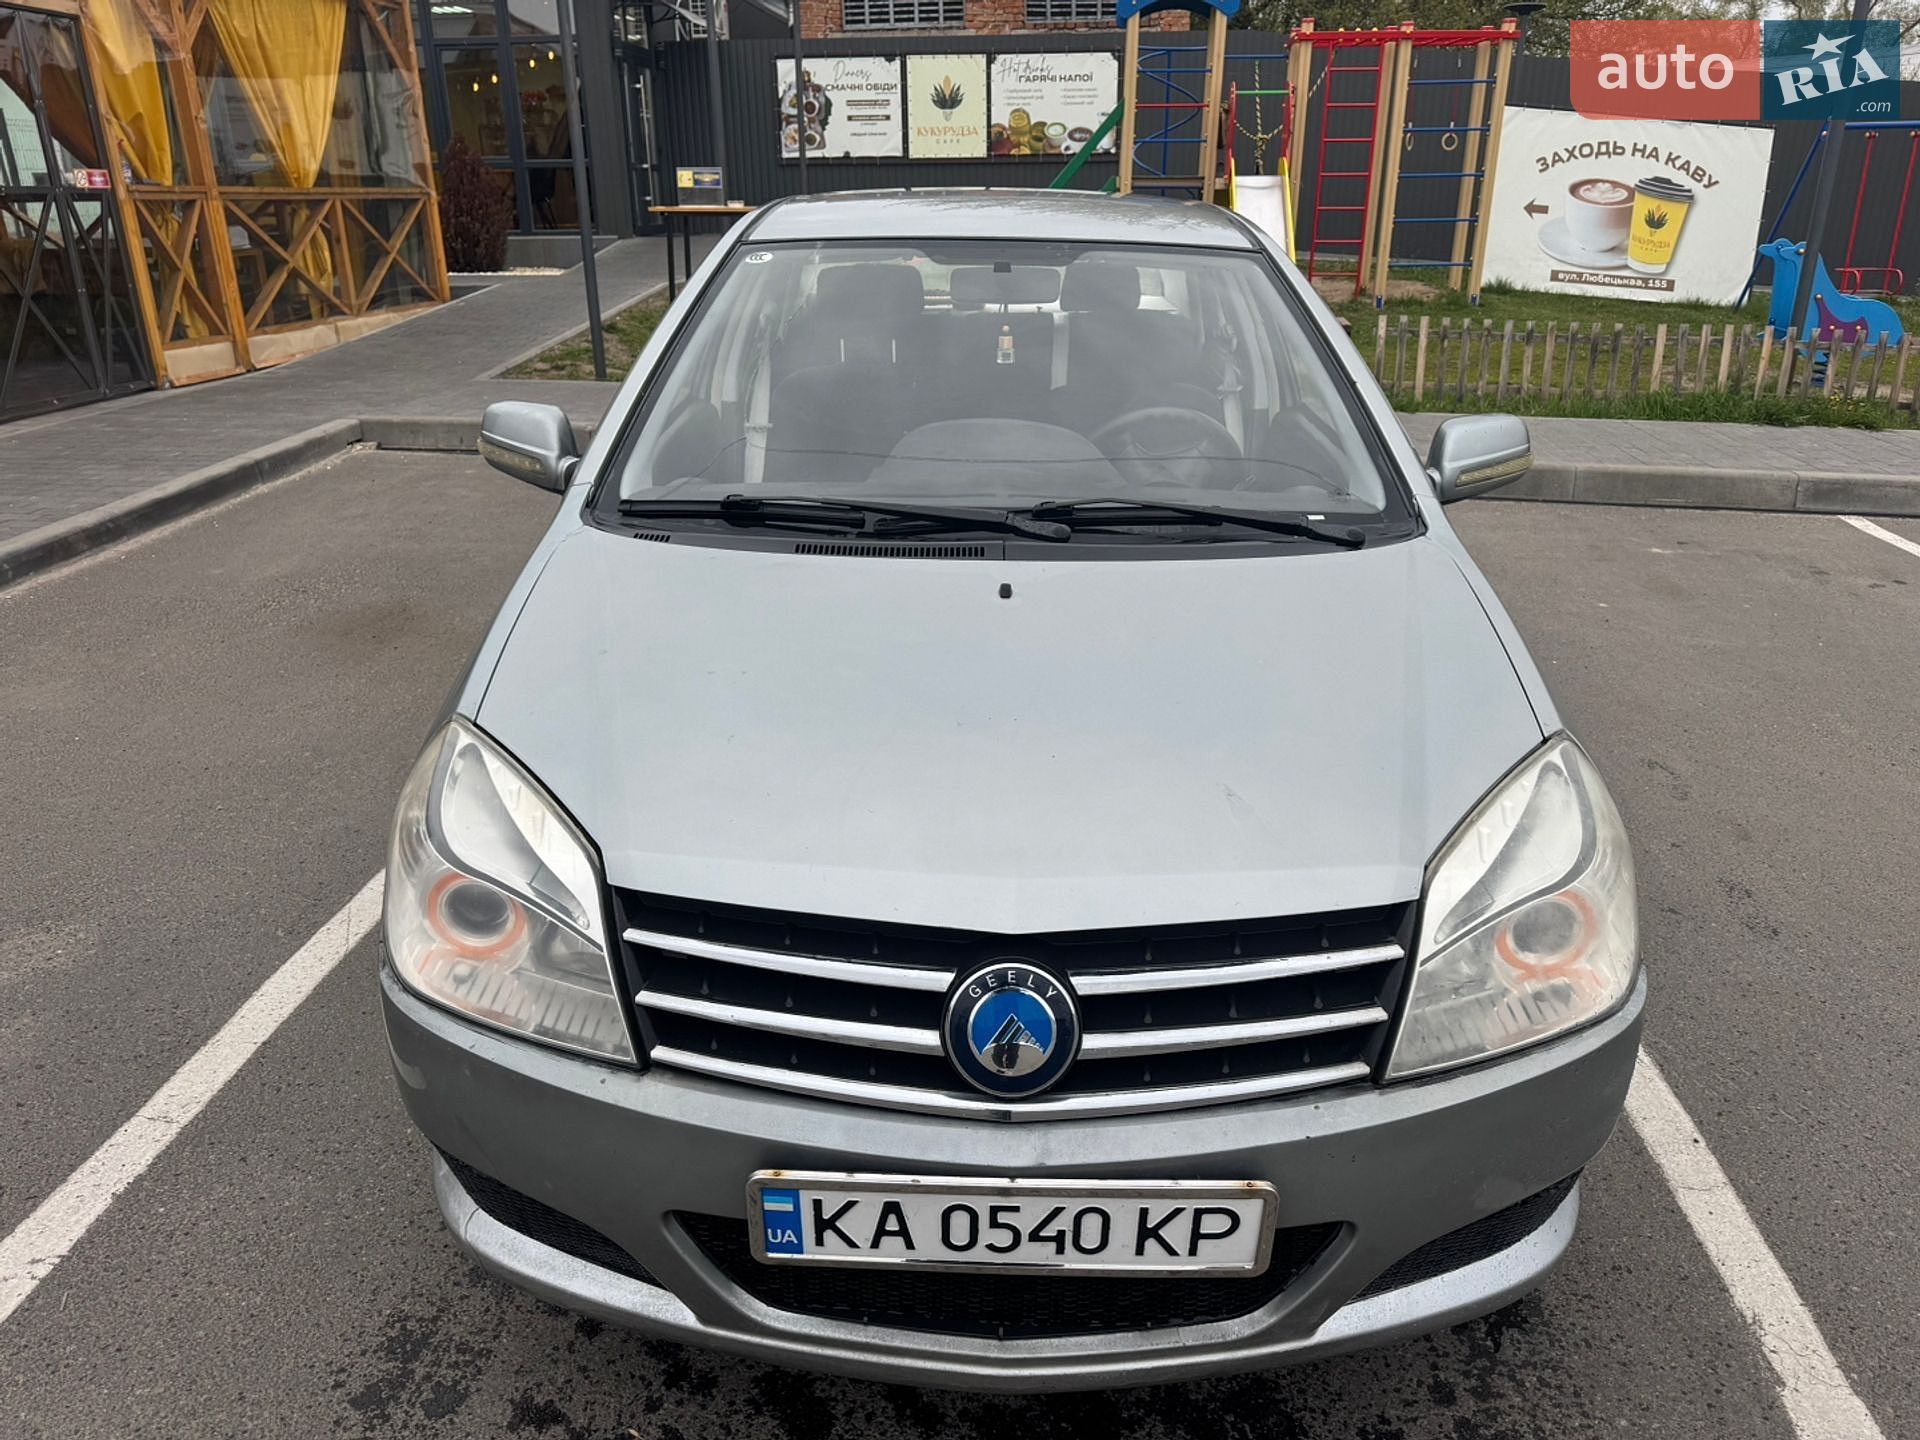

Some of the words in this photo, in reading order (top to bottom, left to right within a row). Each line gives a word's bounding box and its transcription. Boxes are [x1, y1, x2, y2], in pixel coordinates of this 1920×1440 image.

[1019, 74, 1057, 83] ГАРЯЧІ
[1059, 72, 1094, 83] НАПОЇ
[825, 83, 864, 92] СМАЧНІ
[865, 82, 898, 93] ОБІДИ
[916, 126, 979, 137] КУКУРУДЗА
[1536, 140, 1626, 173] ЗАХОДЬ
[1631, 142, 1660, 162] НА
[1664, 152, 1720, 189] КАВУ
[1647, 279, 1668, 289] 155
[969, 970, 1057, 999] GEELY
[812, 1198, 916, 1251] KA
[940, 1203, 1111, 1256] 0540
[1134, 1206, 1242, 1257] KP
[767, 1228, 798, 1244] UA
